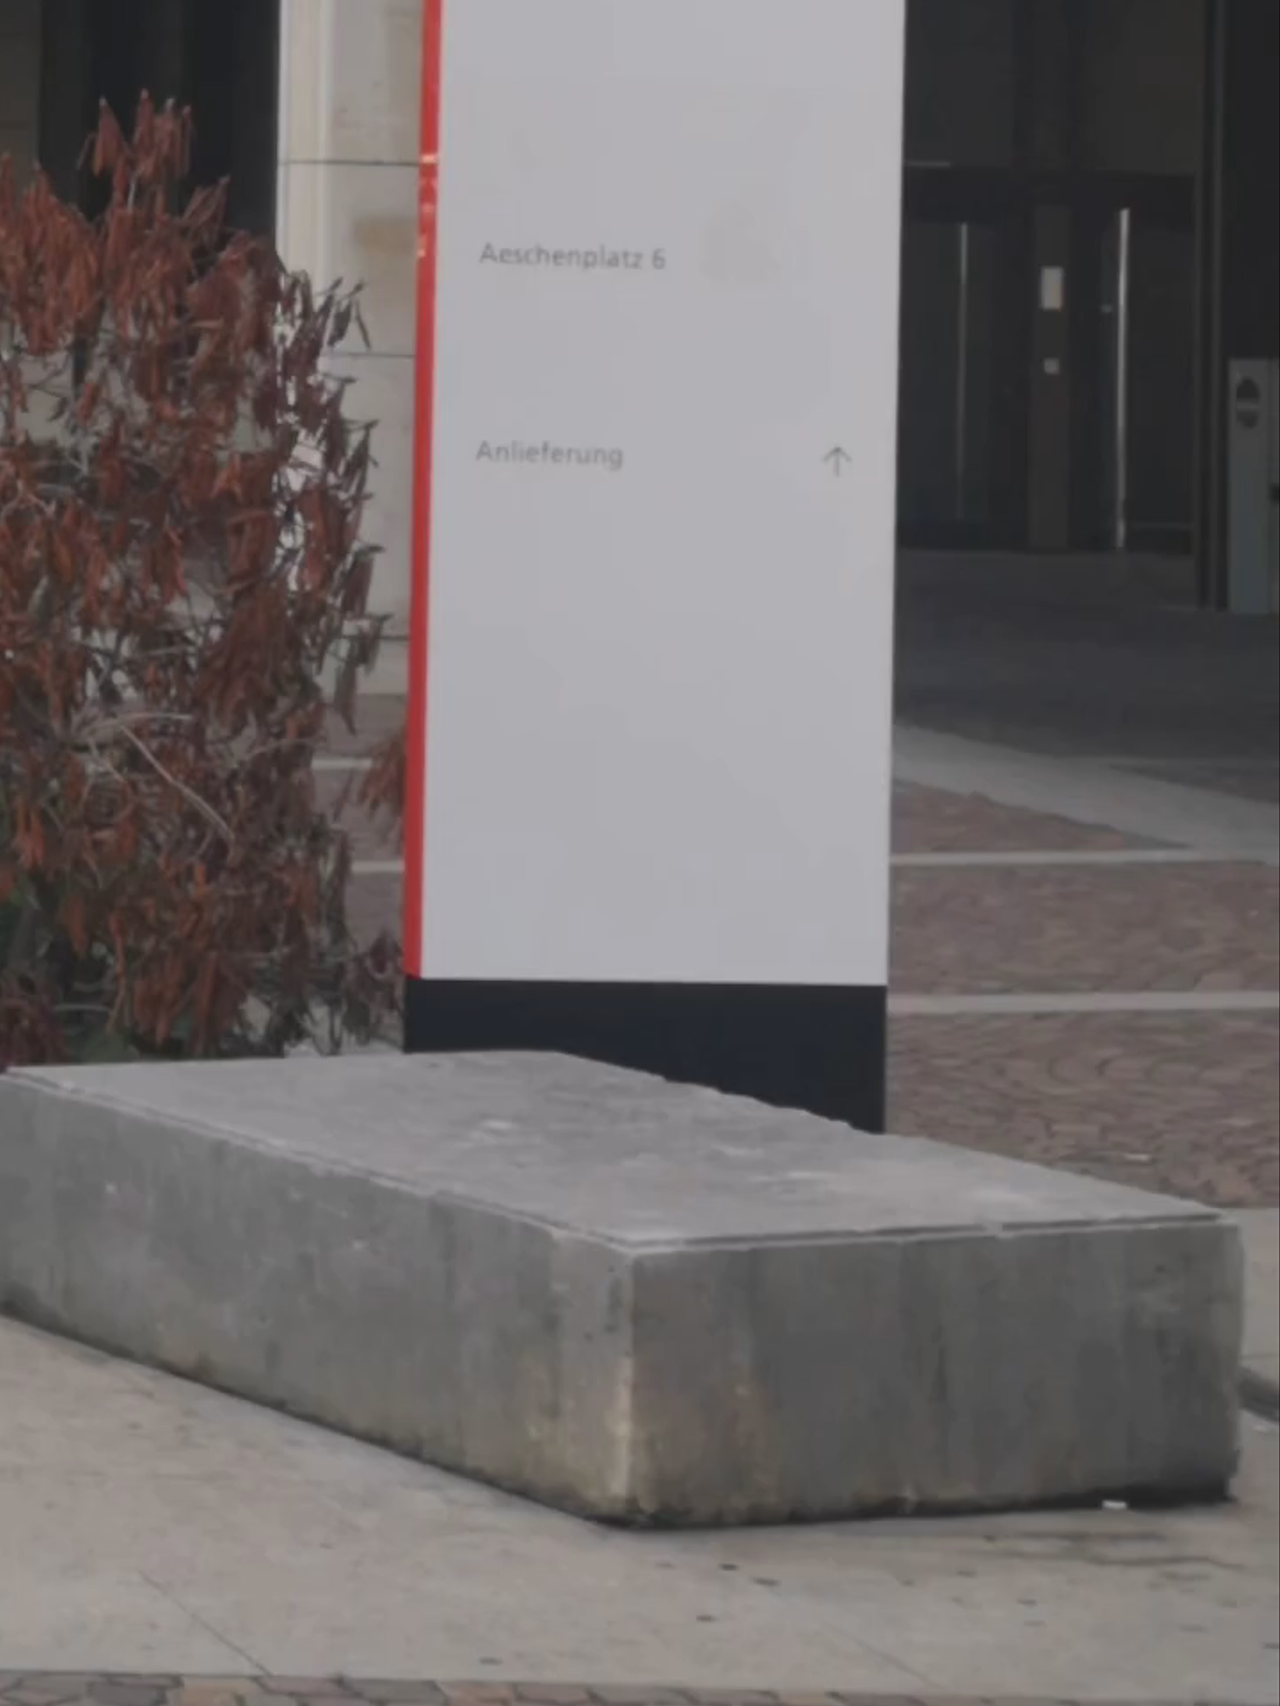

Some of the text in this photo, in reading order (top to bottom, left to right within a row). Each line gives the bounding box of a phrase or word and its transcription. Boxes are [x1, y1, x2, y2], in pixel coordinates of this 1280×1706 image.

[478, 241, 667, 271] Aeschenplatz 6
[474, 439, 624, 472] Anlieferung
